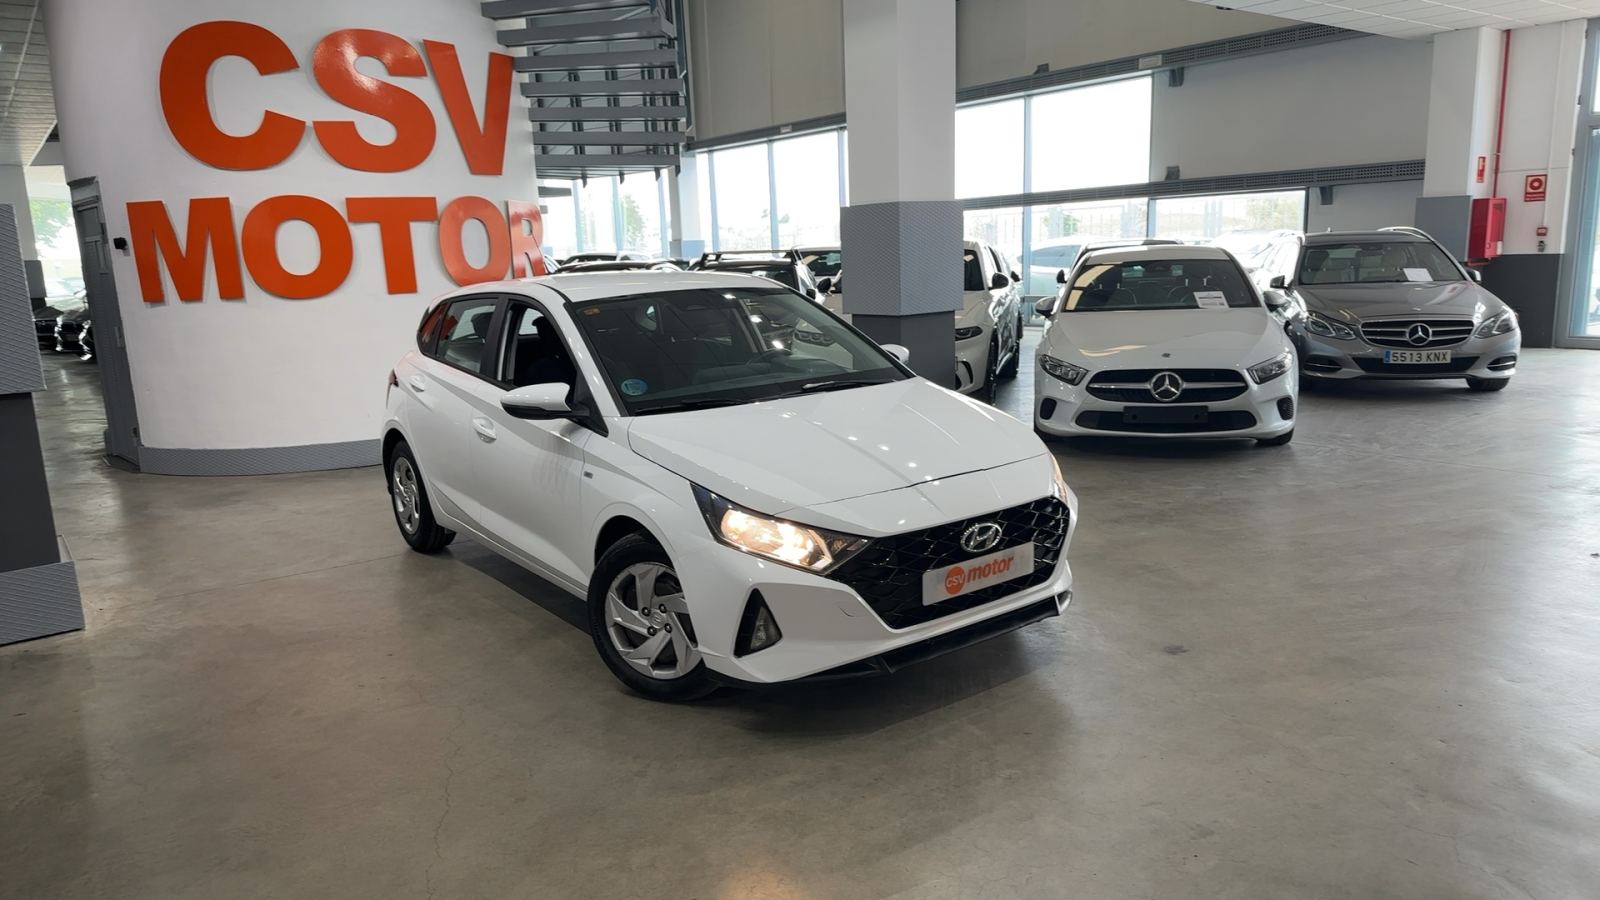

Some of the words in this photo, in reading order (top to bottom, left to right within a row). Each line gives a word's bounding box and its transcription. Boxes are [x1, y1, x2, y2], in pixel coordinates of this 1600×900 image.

[159, 20, 515, 176] CSV
[126, 195, 546, 303] MOTOR
[1392, 352, 1422, 362] 5513
[1426, 352, 1448, 362] KNX
[967, 556, 1014, 582] motor
